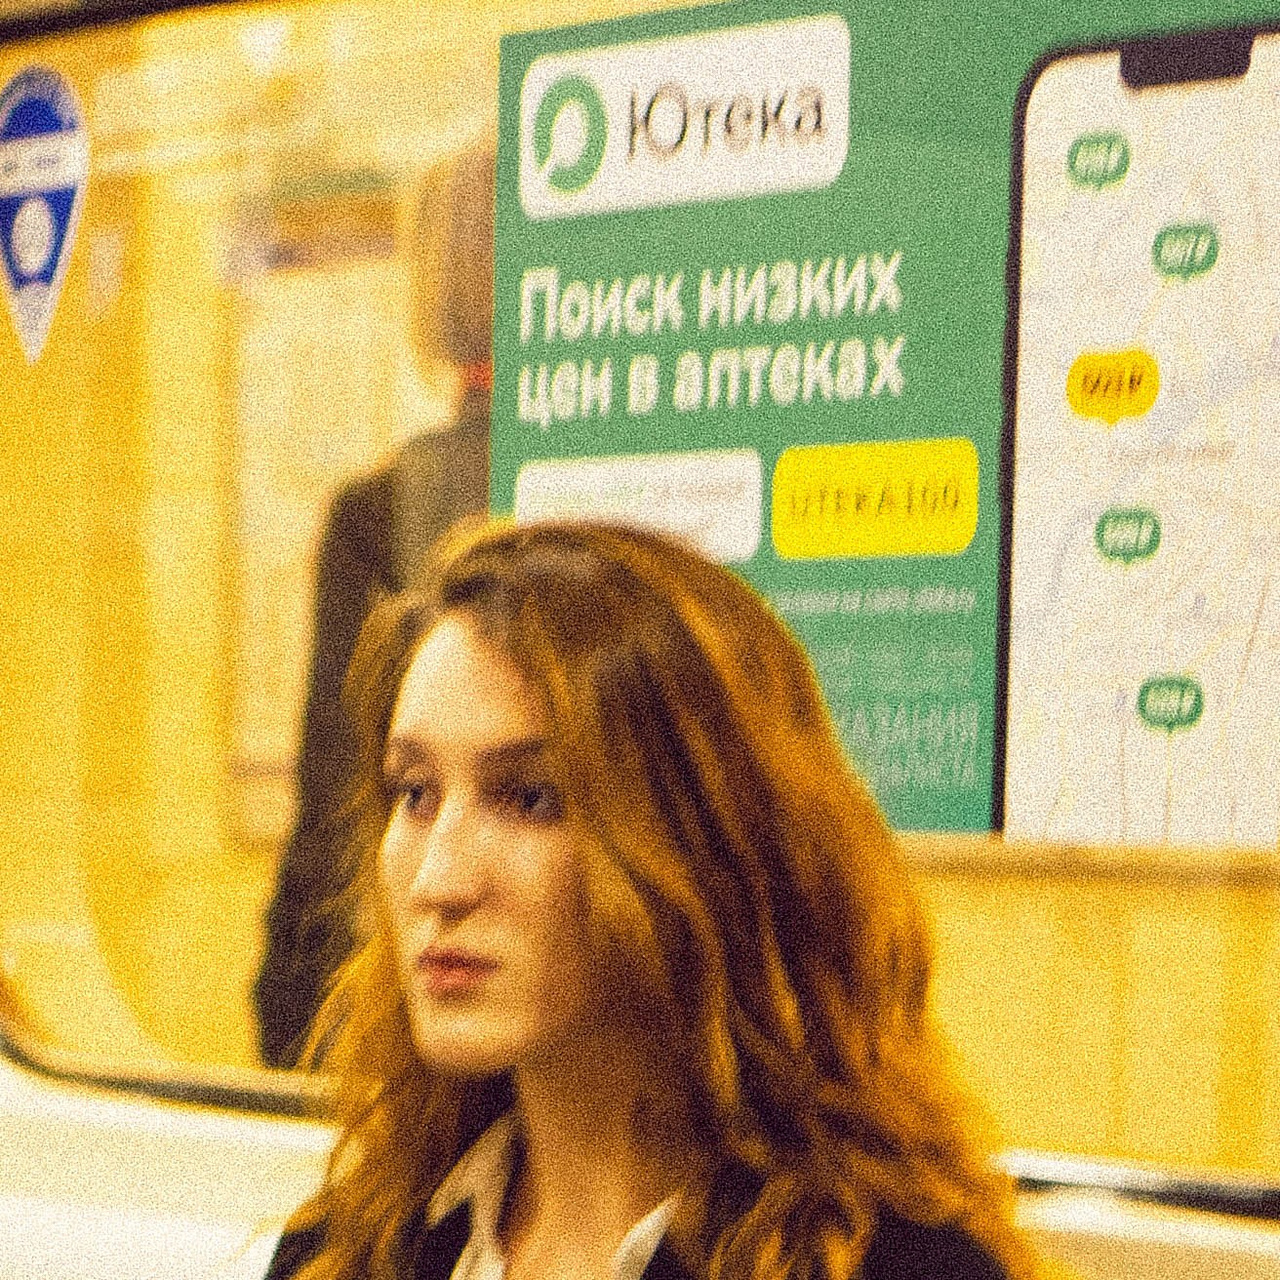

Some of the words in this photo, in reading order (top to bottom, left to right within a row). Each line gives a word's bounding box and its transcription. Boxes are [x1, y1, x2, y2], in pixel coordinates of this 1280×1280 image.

[625, 82, 827, 162] Ютека
[520, 263, 684, 344] Поиск
[699, 249, 903, 330] низких
[517, 354, 613, 432] цен
[627, 353, 660, 416] в
[672, 333, 907, 413] аптеках
